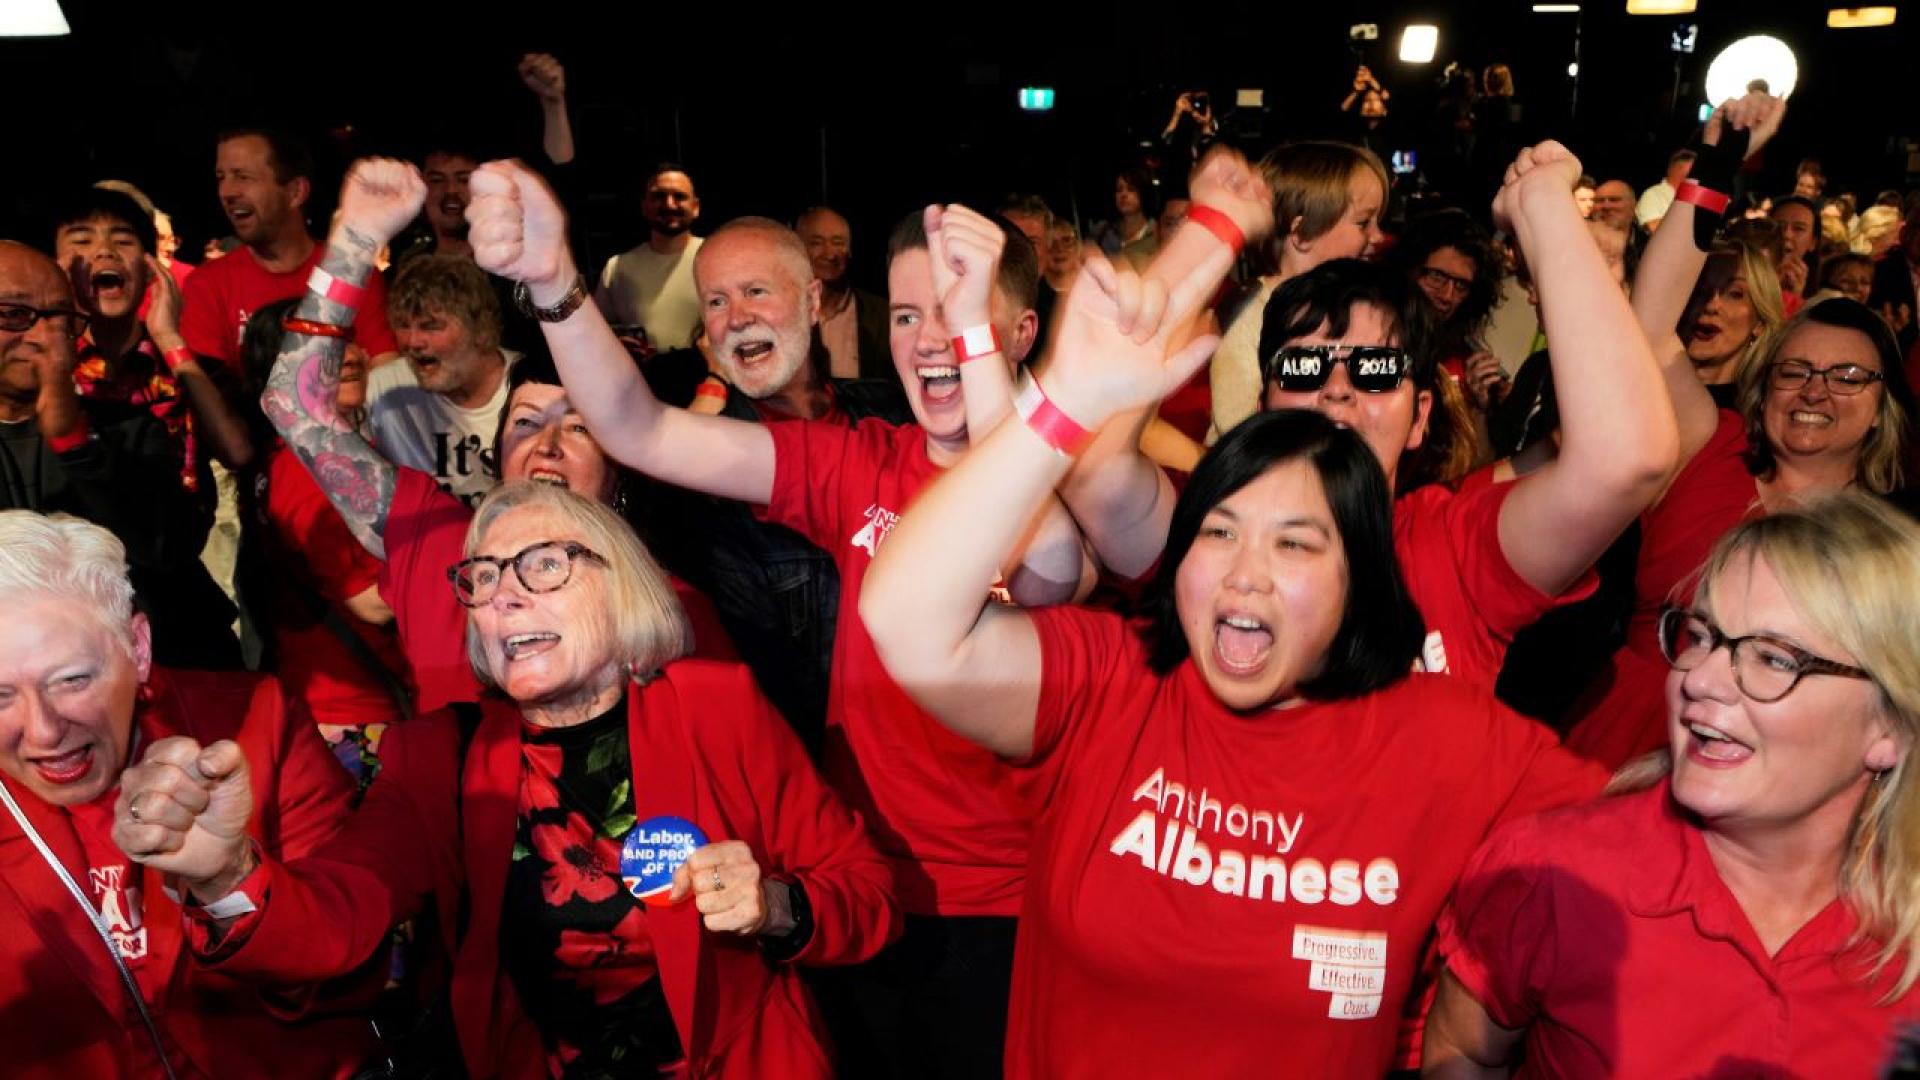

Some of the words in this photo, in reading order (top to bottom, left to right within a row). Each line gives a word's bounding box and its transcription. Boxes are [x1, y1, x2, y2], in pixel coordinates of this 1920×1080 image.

[1282, 356, 1321, 376] ALBO
[1359, 357, 1398, 376] 2025
[1132, 767, 1304, 854] Anthony
[639, 829, 696, 844] Labor.
[1109, 810, 1400, 906] Albanese
[1303, 935, 1379, 961] Progressive.
